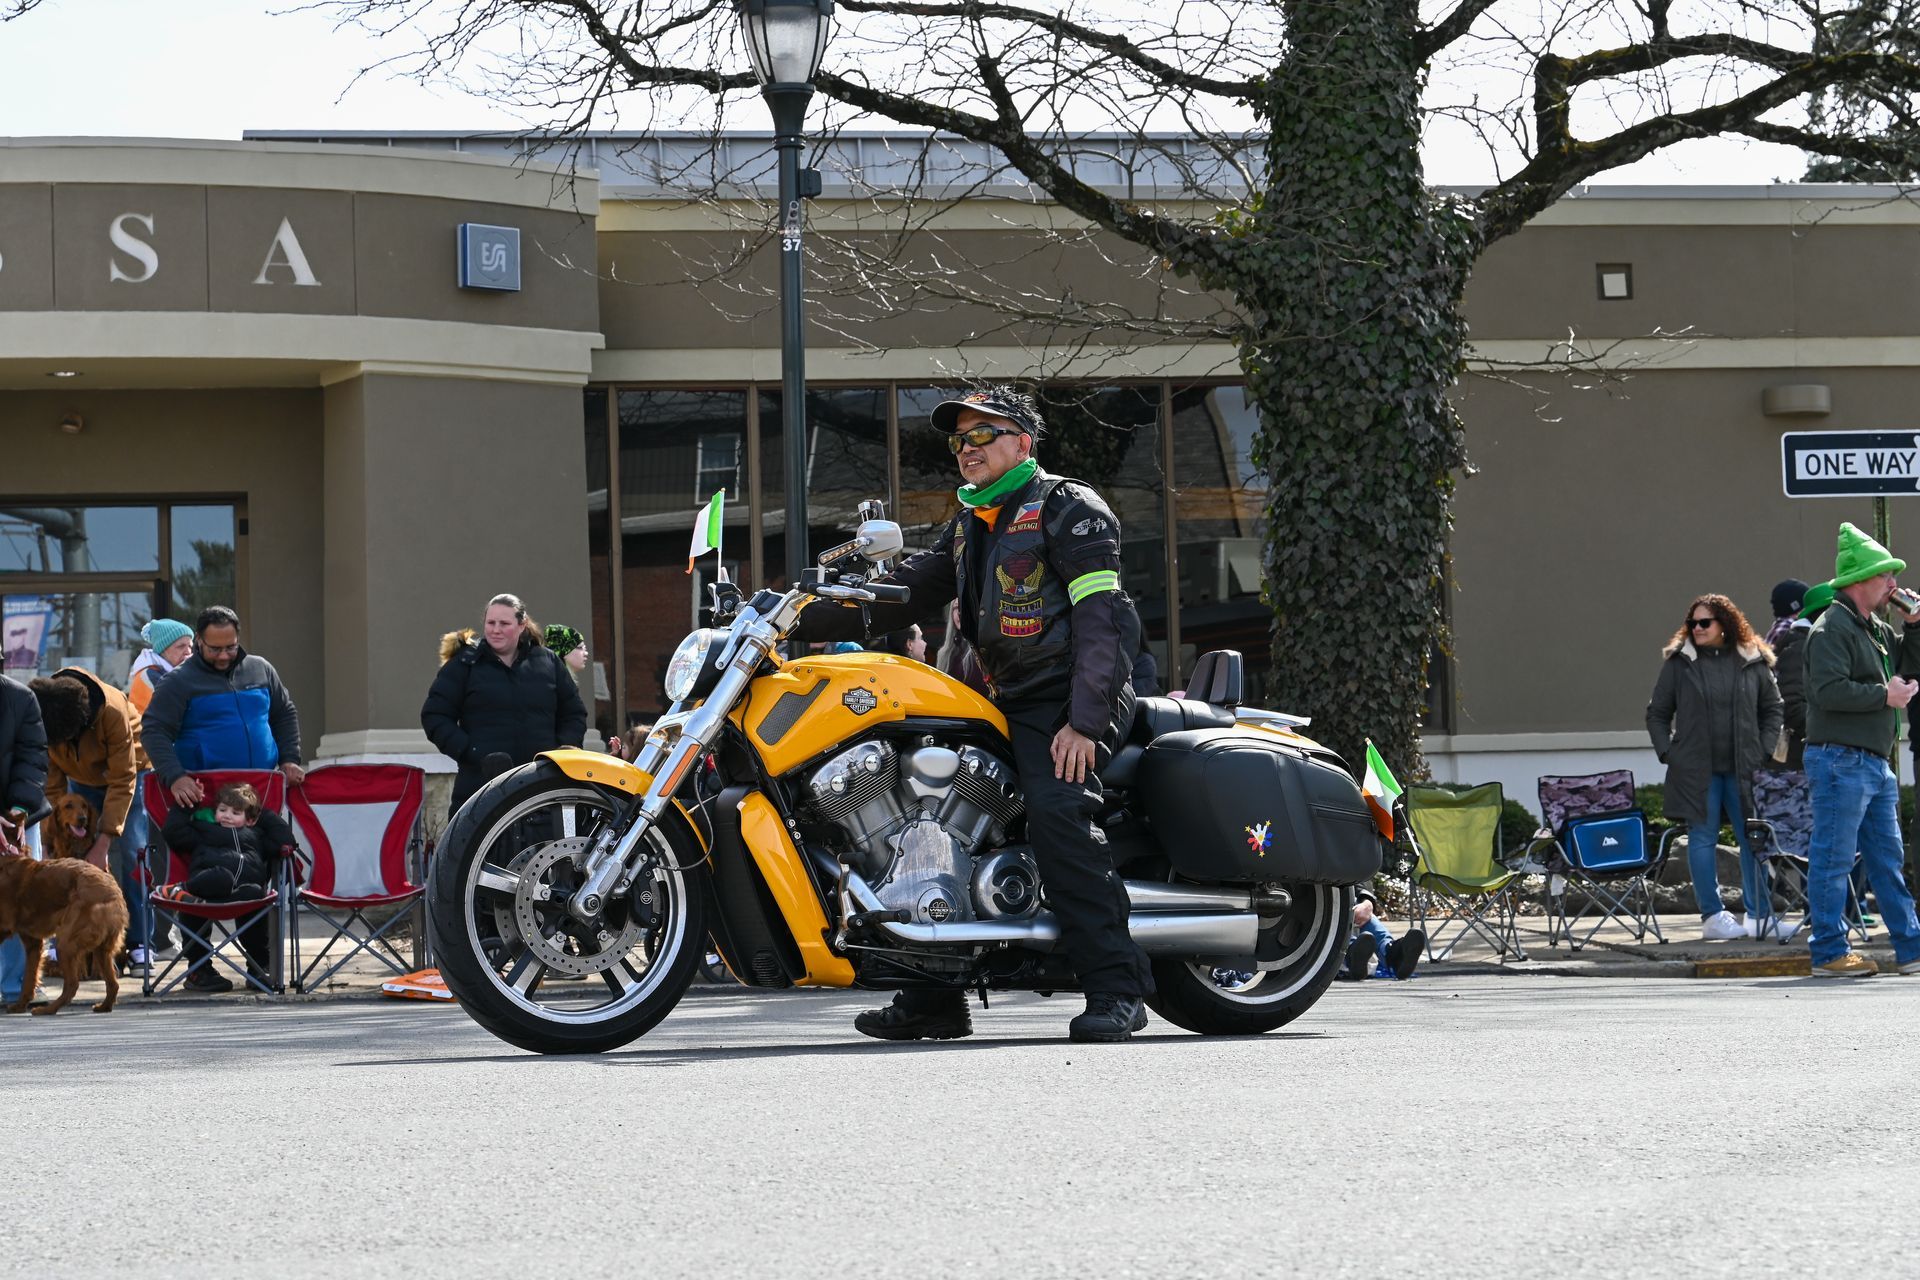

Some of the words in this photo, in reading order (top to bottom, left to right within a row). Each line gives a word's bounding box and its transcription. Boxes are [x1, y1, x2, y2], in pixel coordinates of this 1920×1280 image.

[783, 238, 801, 252] 37
[1805, 453, 1858, 476] ONE
[1866, 452, 1916, 475] WAY
